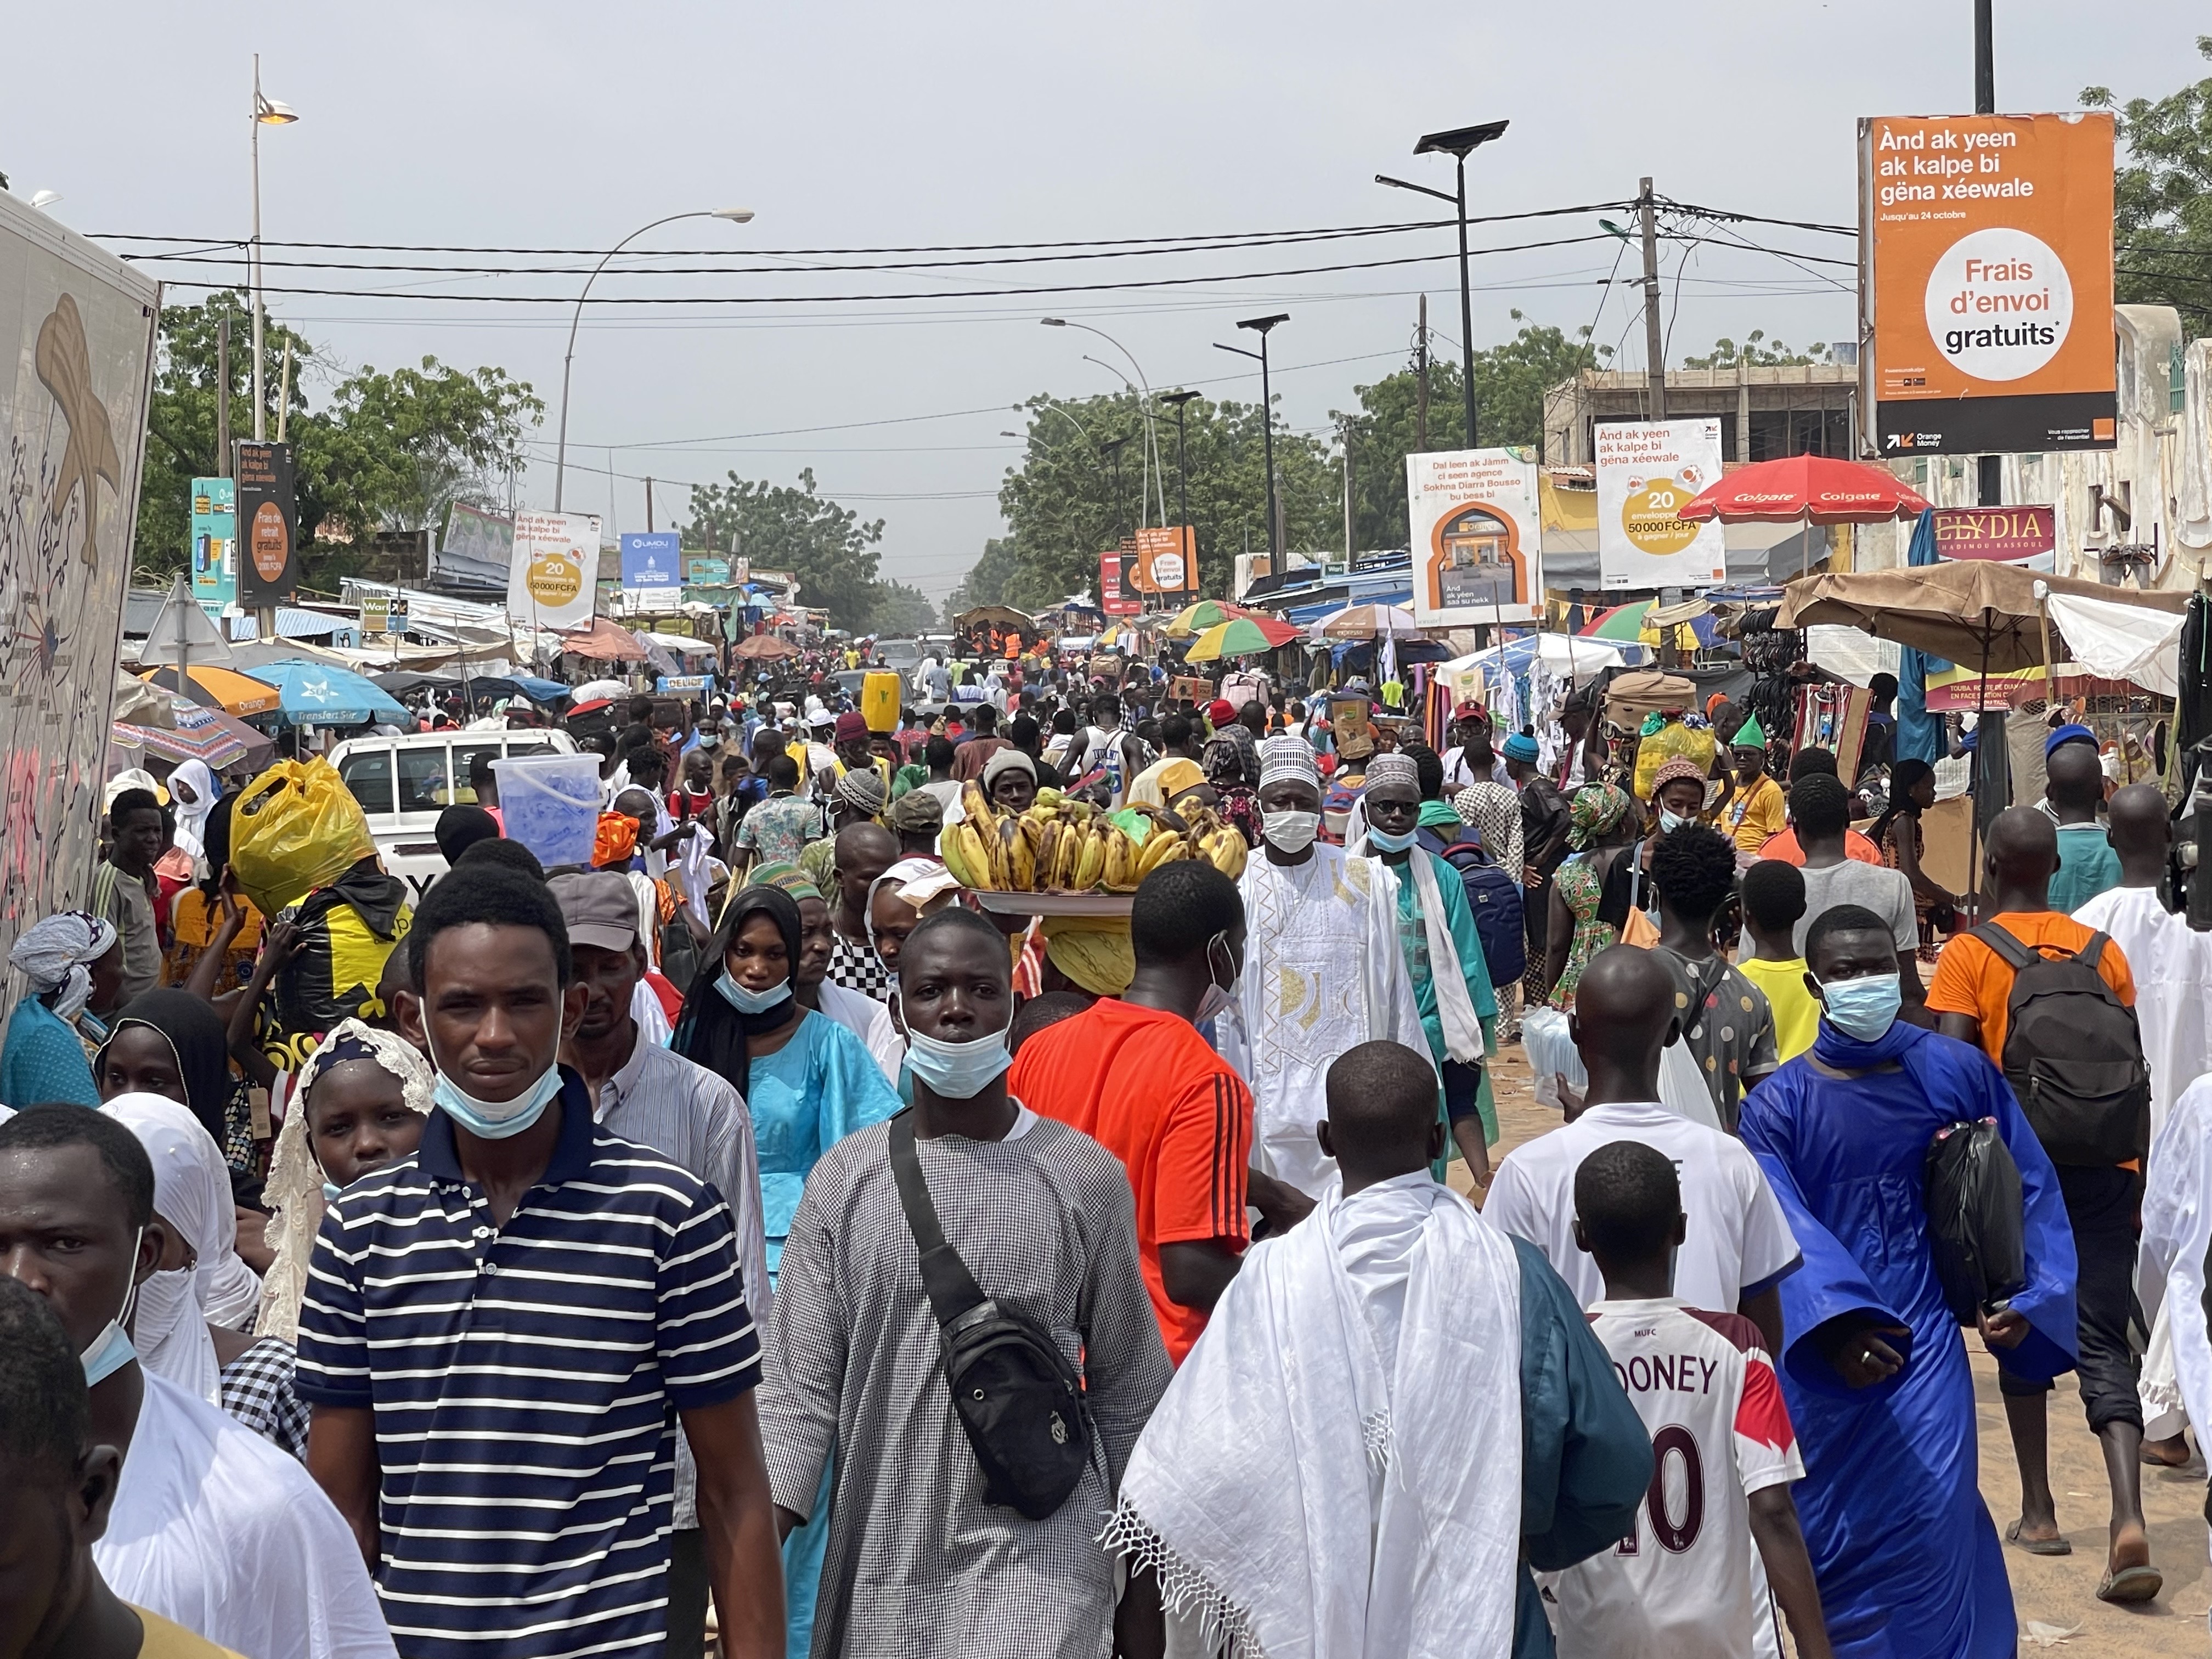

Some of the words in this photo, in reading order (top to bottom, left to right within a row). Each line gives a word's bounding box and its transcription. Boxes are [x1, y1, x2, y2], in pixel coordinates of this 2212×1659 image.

[1879, 126, 1924, 150] Ànd
[1931, 129, 1958, 149] ak
[1963, 132, 2016, 153] yeen
[1880, 156, 1908, 176] ak
[1914, 155, 1973, 178] kalpe
[1980, 154, 1999, 173] bi
[1881, 182, 1936, 206] gëna
[1942, 178, 2034, 199] xéewale
[1933, 211, 1966, 219] octobre
[1966, 258, 2033, 283] Frais
[1950, 287, 2050, 314] d'envoi
[1599, 428, 1622, 441] Ànd
[1626, 430, 1639, 439] ak
[1643, 430, 1670, 441] yeen
[1917, 432, 1942, 441] Orange
[1600, 444, 1614, 453] ak
[1617, 442, 1648, 453] kalpe
[1651, 441, 1662, 450] bi
[1917, 439, 1940, 448] Money
[1449, 461, 1468, 469] leen
[1482, 458, 1509, 466] Jàmm
[1600, 455, 1629, 467] gëna
[1632, 453, 1680, 464] xéewale
[1471, 470, 1503, 479] agence
[1424, 483, 1456, 492] Sokhna
[1459, 481, 1485, 489] Diarra
[1487, 478, 1521, 487] Bousso
[1464, 492, 1485, 500] bess
[1649, 492, 1675, 509] 20
[1734, 493, 1797, 503] Colgate
[1820, 493, 1881, 502] Colgate
[258, 512, 273, 523] Frais
[1665, 521, 1697, 531] FCFA
[1934, 513, 2043, 541] ELYDIA
[1675, 531, 1690, 539] jour
[545, 562, 565, 575] 20
[668, 678, 703, 688] DELICE
[239, 698, 266, 711] Orange
[298, 711, 338, 720] Transfert
[1634, 1328, 1657, 1338] MUFC
[1613, 1423, 1706, 1558] 0
